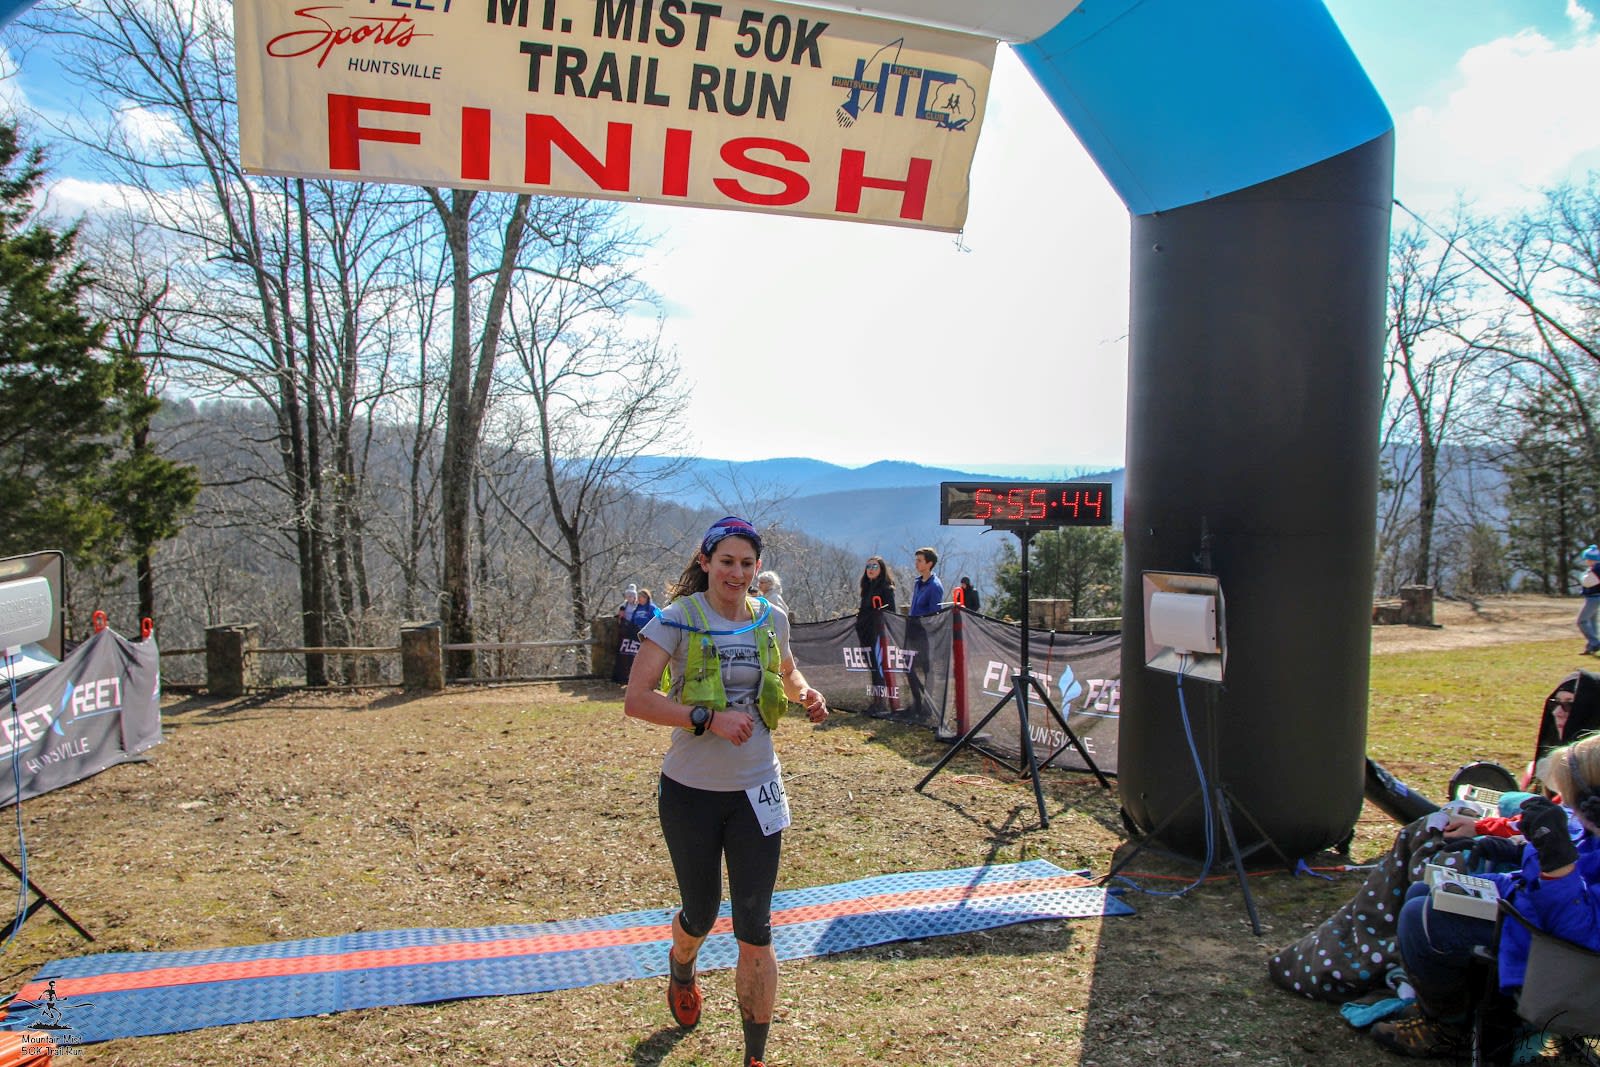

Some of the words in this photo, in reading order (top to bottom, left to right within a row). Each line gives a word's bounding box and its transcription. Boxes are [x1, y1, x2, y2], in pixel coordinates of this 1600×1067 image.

[266, 6, 434, 68] Sports
[592, 0, 722, 52] MIST
[734, 9, 830, 68] 50K
[348, 57, 443, 80] HUNTSVILLE
[519, 41, 670, 107] TRAIL
[687, 62, 792, 122] RUN
[832, 77, 878, 91] HUNTSVILLE
[894, 65, 920, 78] TRACK
[327, 93, 933, 221] FINISH
[842, 646, 873, 668] FLEET
[72, 676, 121, 716] FEET
[983, 660, 1053, 700] FLET
[1083, 678, 1120, 713] FEE
[758, 781, 785, 806] 40
